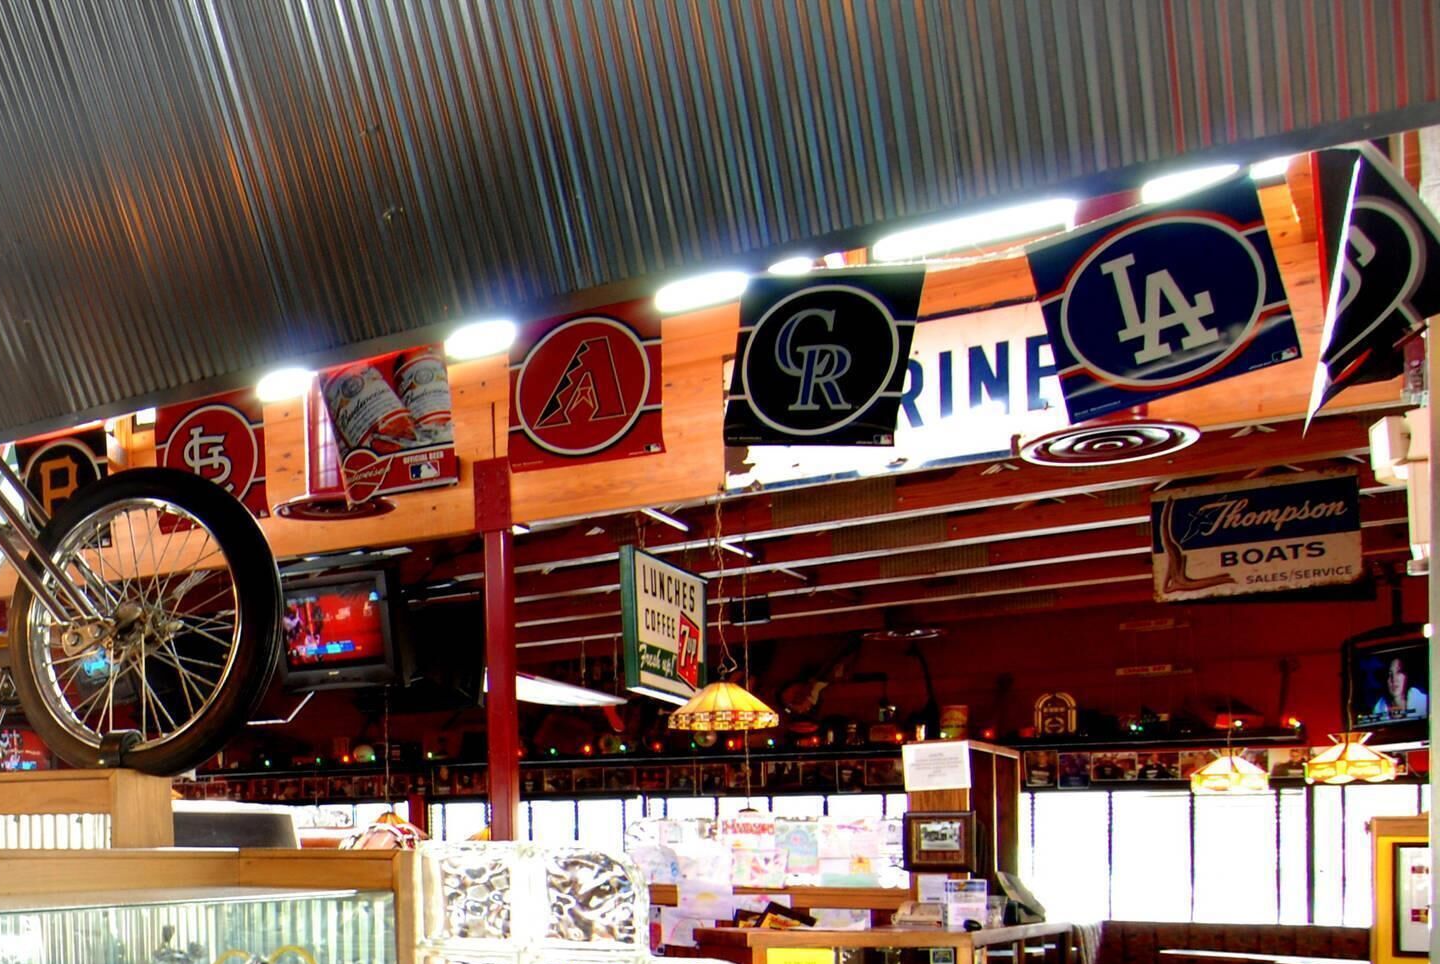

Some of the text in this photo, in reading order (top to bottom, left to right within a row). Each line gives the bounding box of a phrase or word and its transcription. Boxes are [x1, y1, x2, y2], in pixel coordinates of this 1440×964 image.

[1101, 253, 1219, 365] LA
[774, 308, 853, 412] CR
[1198, 497, 1349, 537] Thompson
[1219, 541, 1326, 568] BOATS
[642, 563, 696, 613] LUNCHES
[1245, 565, 1353, 585] SALES/SERVICE
[644, 607, 676, 640] COFFEE
